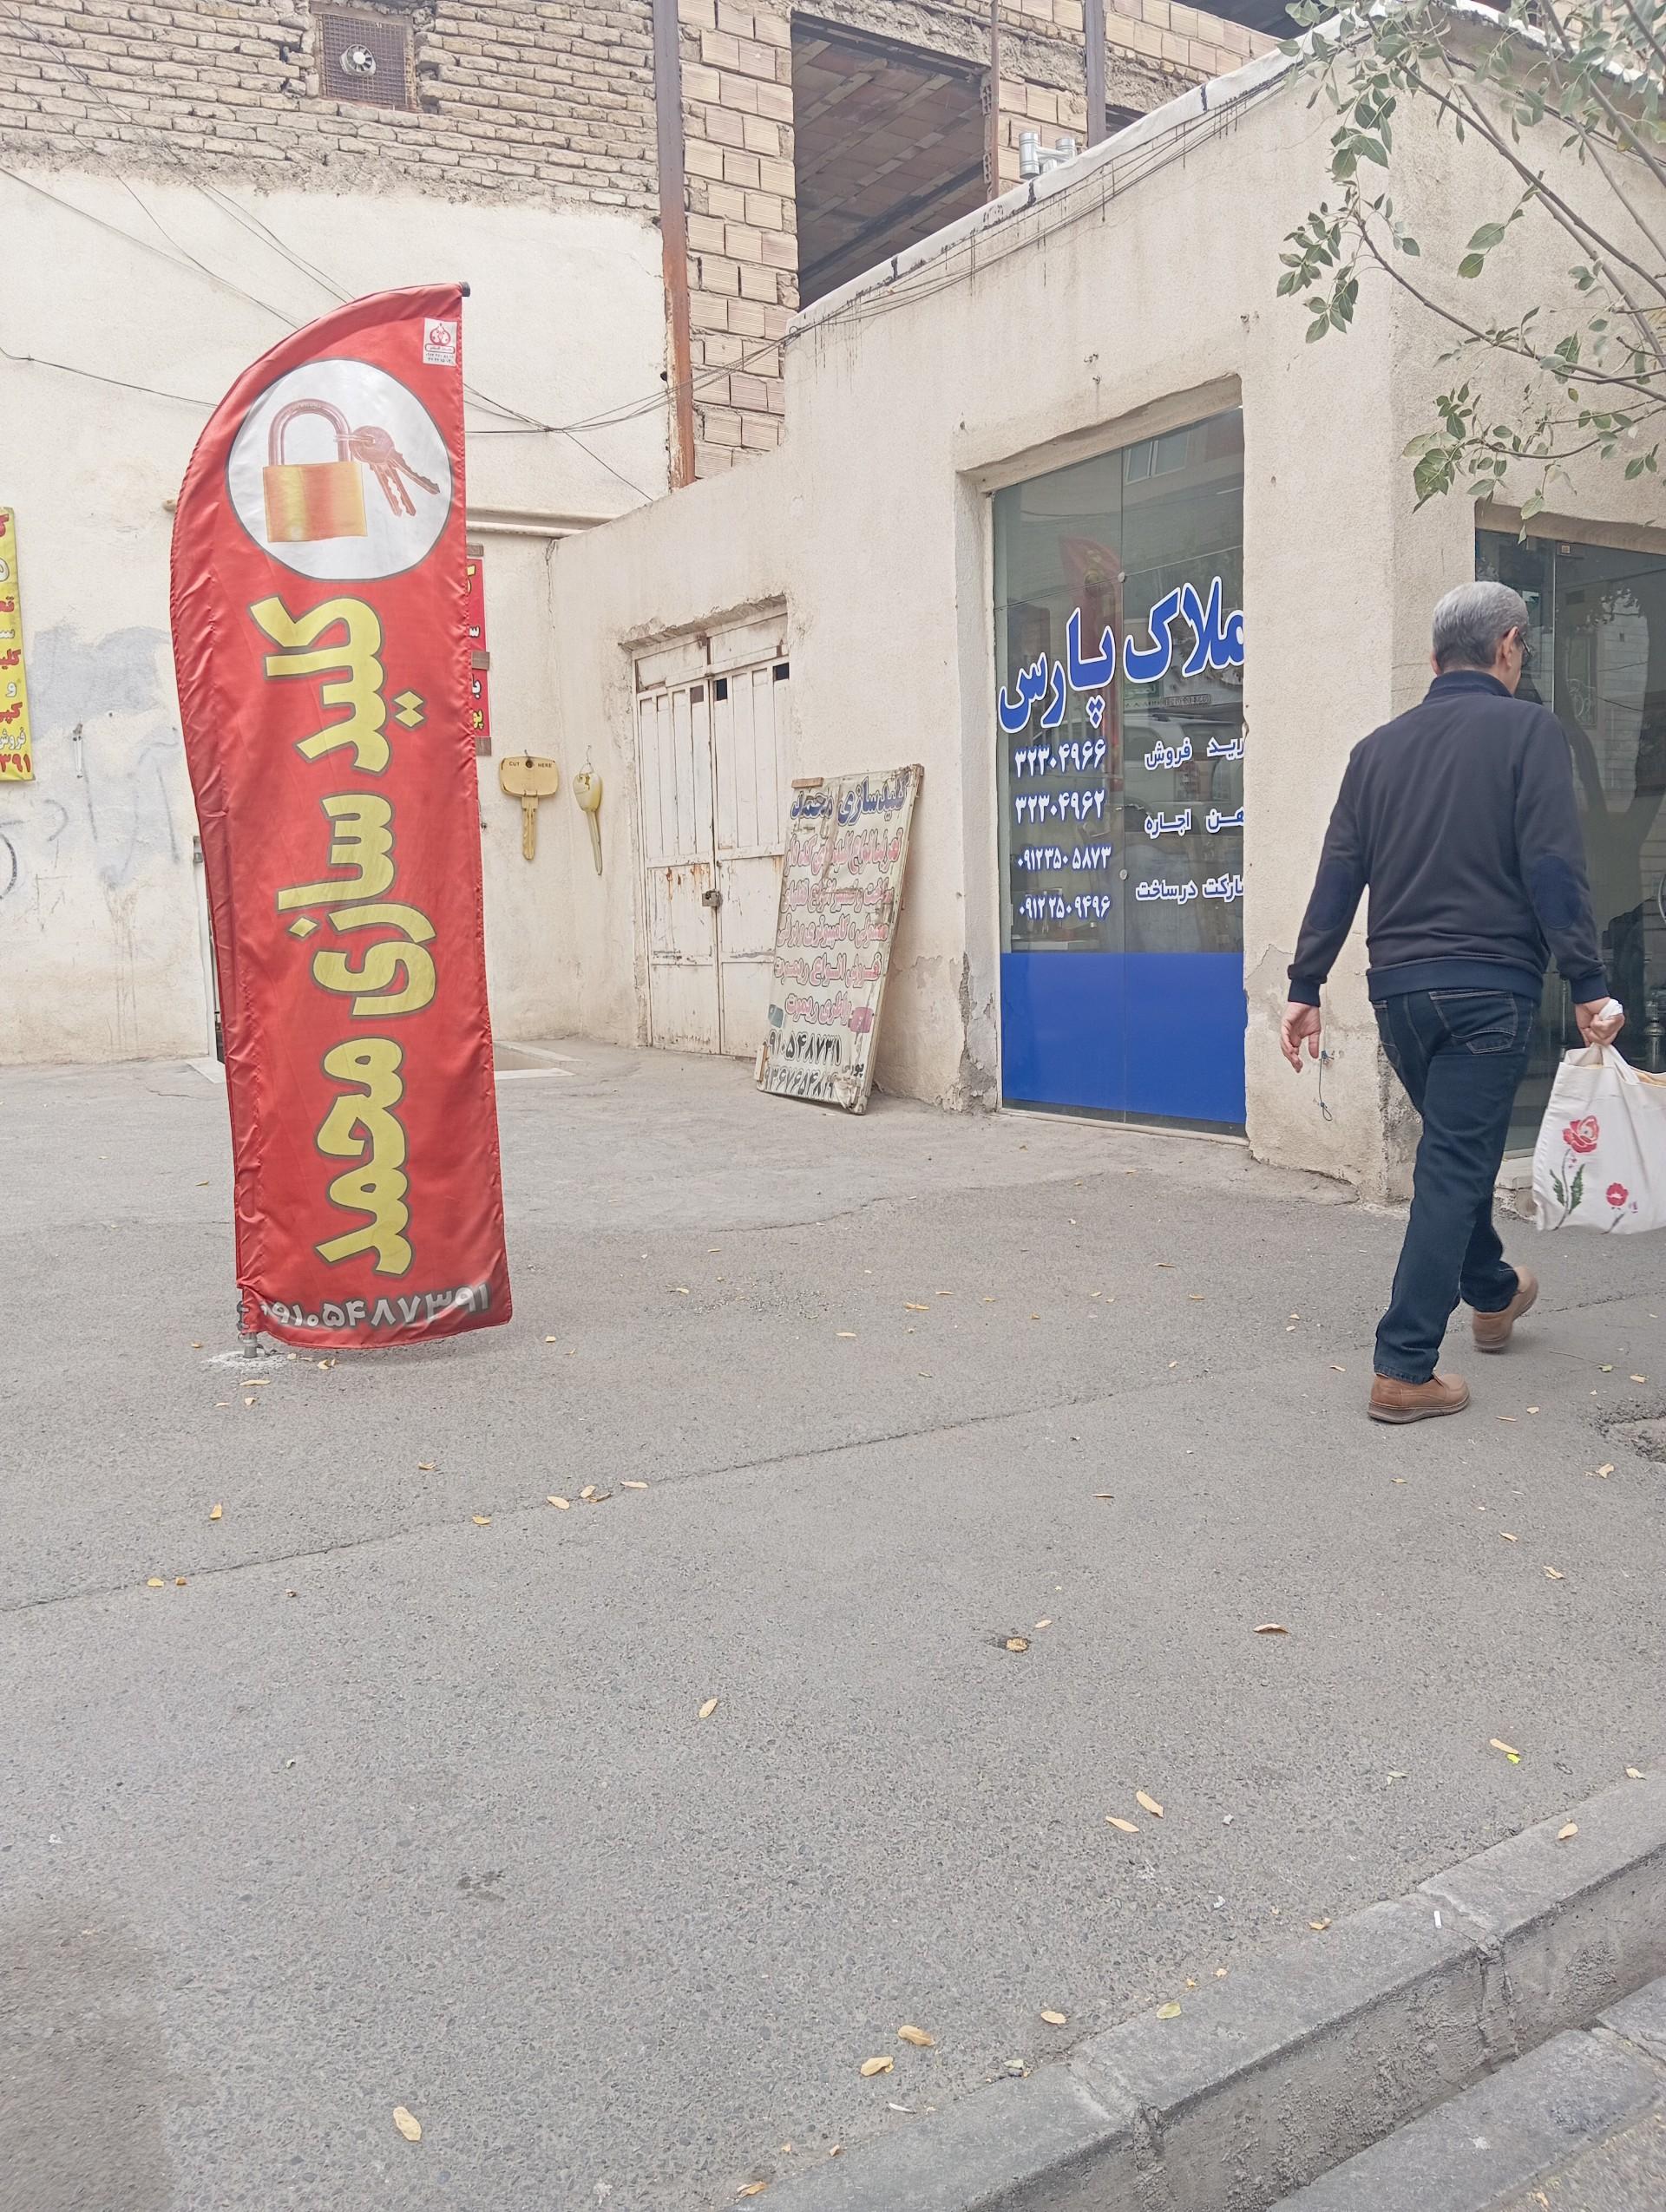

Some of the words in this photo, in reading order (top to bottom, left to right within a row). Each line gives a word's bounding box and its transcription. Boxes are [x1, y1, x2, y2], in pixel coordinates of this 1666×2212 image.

[1123, 576, 1243, 684] ملاک
[999, 605, 1115, 733] پارس
[1015, 738, 1106, 778] ۳۲۳۰۴۹۶۶
[1145, 737, 1193, 770] فروش
[1015, 789, 1105, 824] ۳۲۳۰۴۹۶۲
[1145, 808, 1192, 839] اجاره
[314, 1037, 413, 1276] محمد
